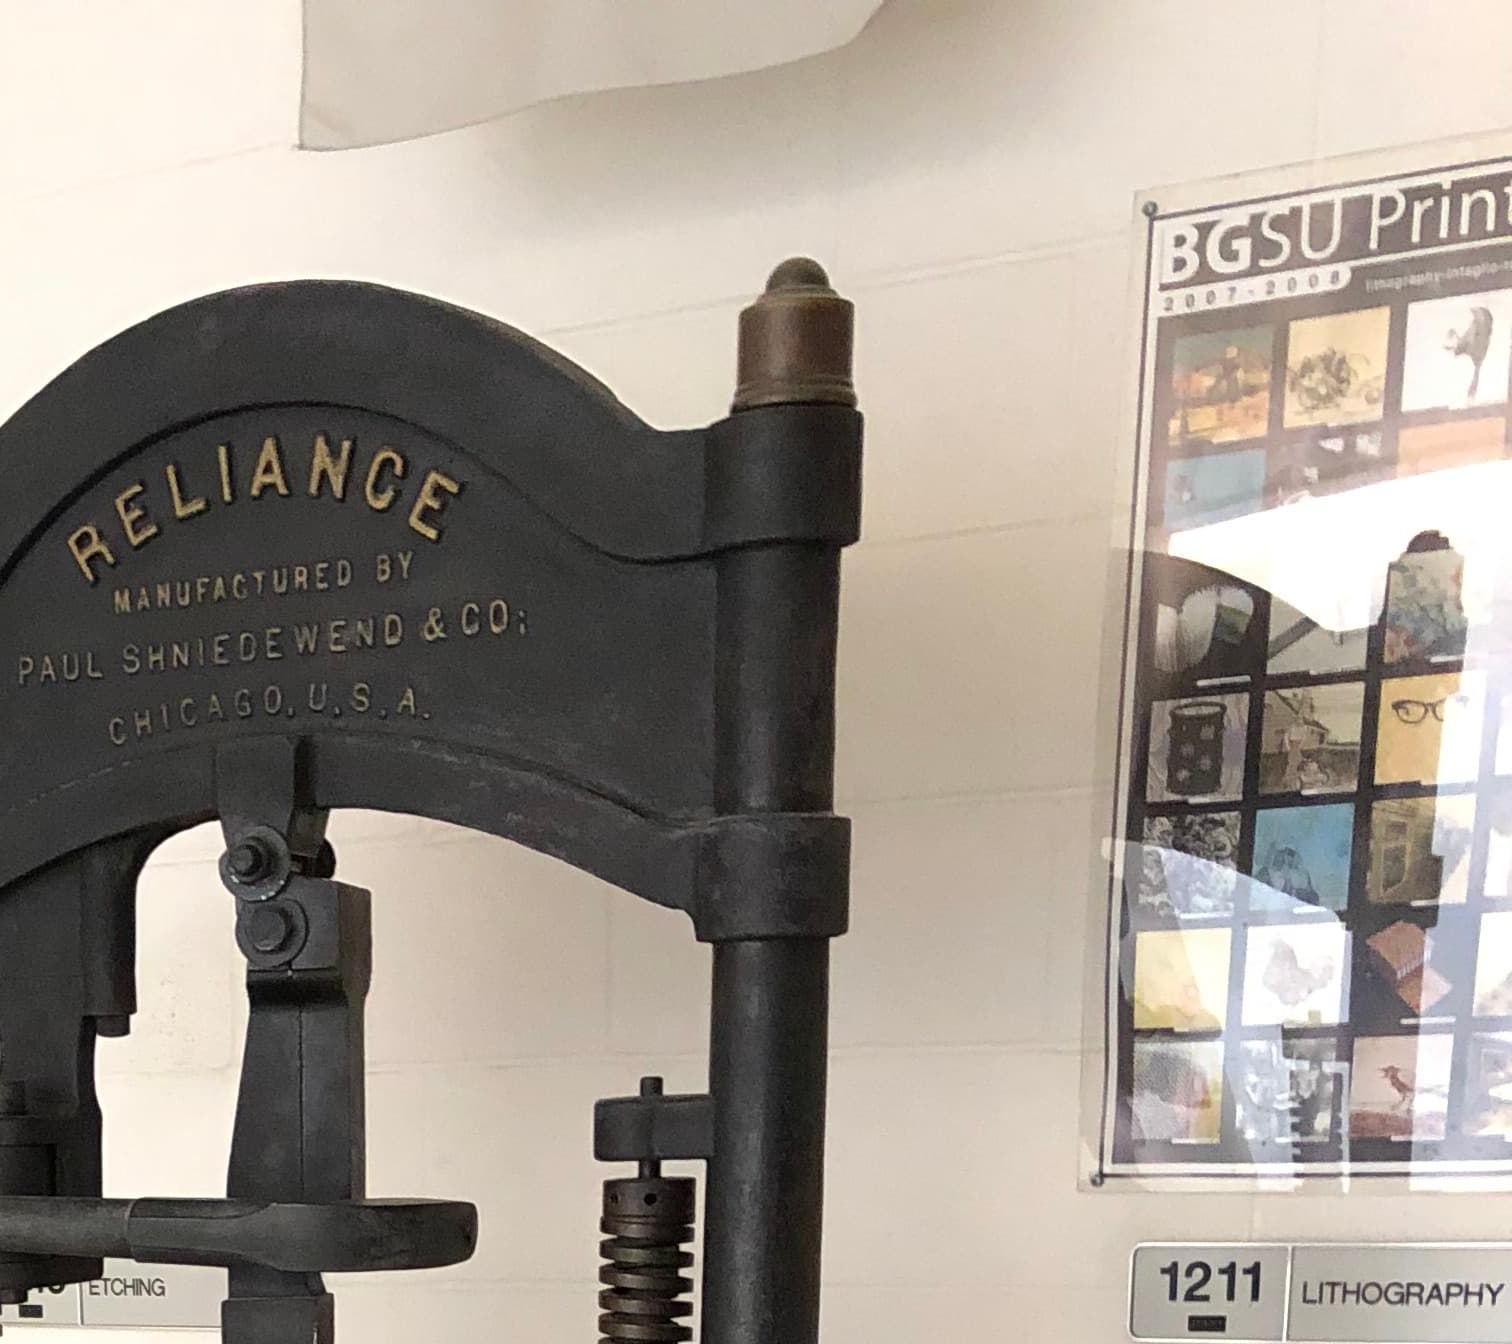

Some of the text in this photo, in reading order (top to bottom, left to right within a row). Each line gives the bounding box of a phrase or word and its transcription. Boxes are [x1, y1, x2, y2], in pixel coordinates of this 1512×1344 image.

[1160, 197, 1343, 283] BGSU
[66, 435, 461, 583] RELIANCE
[112, 551, 415, 615] MANUFACTURED BY
[18, 650, 105, 686] PAUL
[422, 607, 448, 643] &
[88, 1277, 166, 1297] ETCHING
[1159, 1260, 1505, 1306] 1211 LITHOGRAPHY
